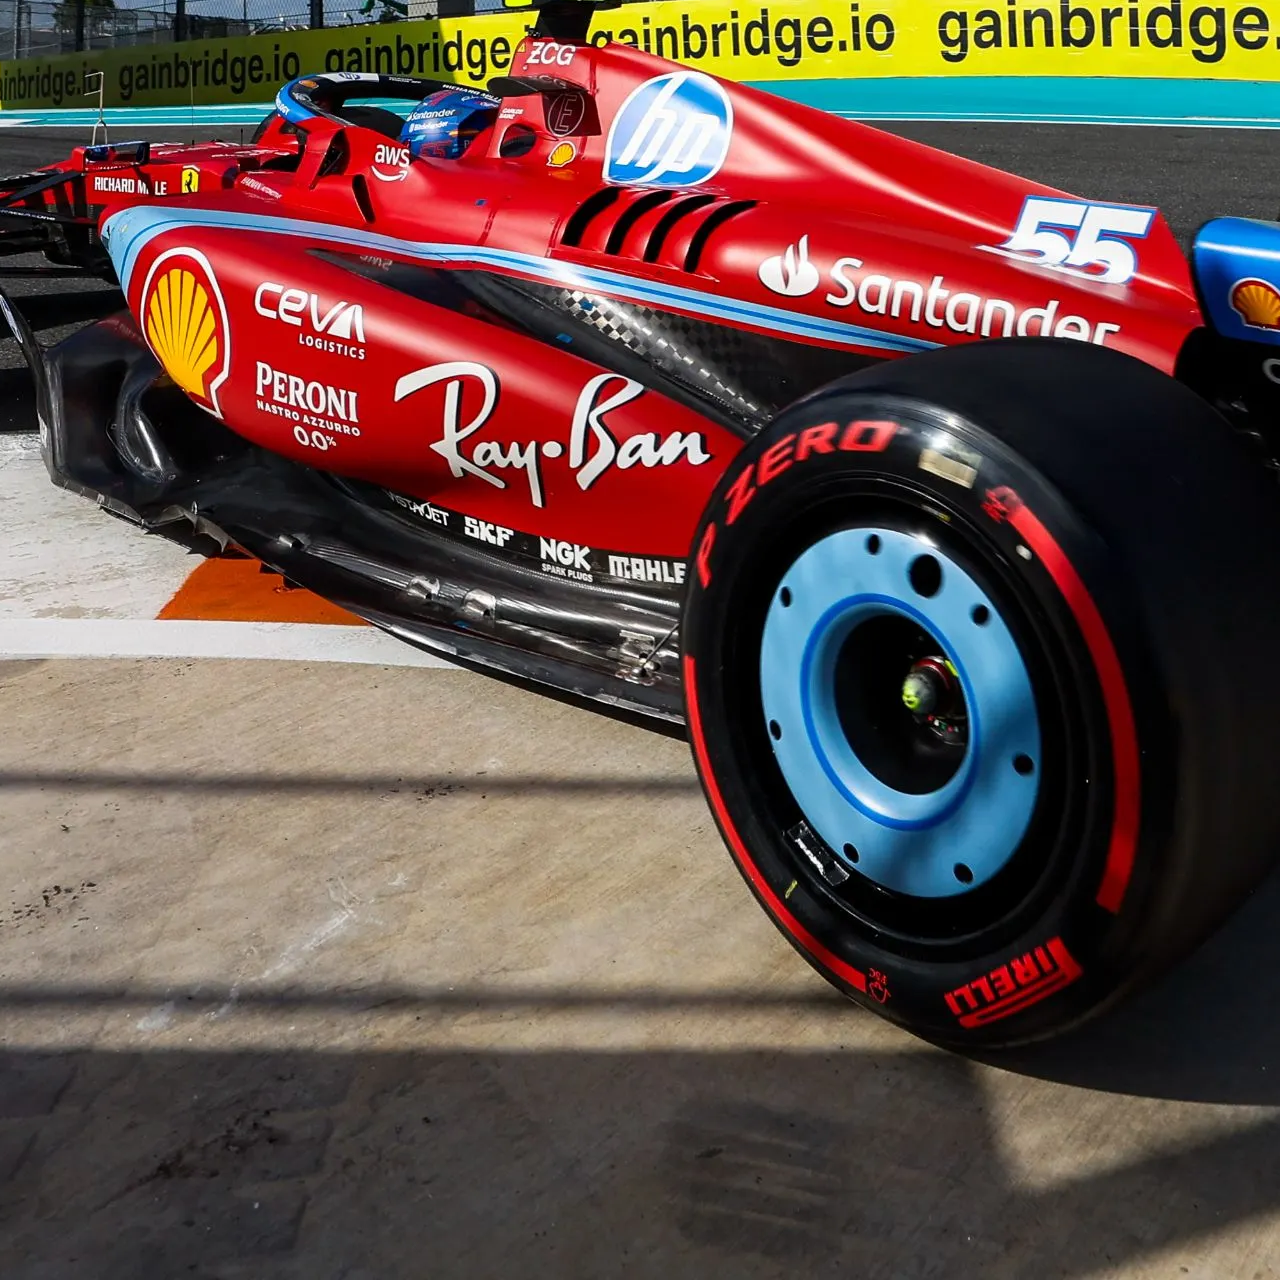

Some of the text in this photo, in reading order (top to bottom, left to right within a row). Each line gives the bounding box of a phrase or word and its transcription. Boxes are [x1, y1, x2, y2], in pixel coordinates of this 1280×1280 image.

[325, 24, 531, 81] gainbridge
[526, 41, 576, 66] ZCG
[120, 44, 300, 98] gainbridge.io
[411, 109, 456, 121] Santander
[615, 72, 721, 186] hp
[375, 144, 410, 168] aws
[94, 176, 168, 196] RICHARD MLE
[988, 195, 1156, 285] 55
[825, 257, 1121, 345] Santander
[299, 333, 365, 360] LOGISTICS
[256, 361, 358, 422] PERONI
[257, 400, 361, 437] NASTRO AZZURRO
[293, 426, 337, 451] 0.0%
[724, 420, 902, 526] ZERO
[464, 516, 514, 548] SKF
[540, 536, 591, 571] NGK
[608, 555, 687, 584] MAHLE
[542, 563, 593, 583] SPARK PLUGS
[943, 936, 1084, 1029] PIRELLI
